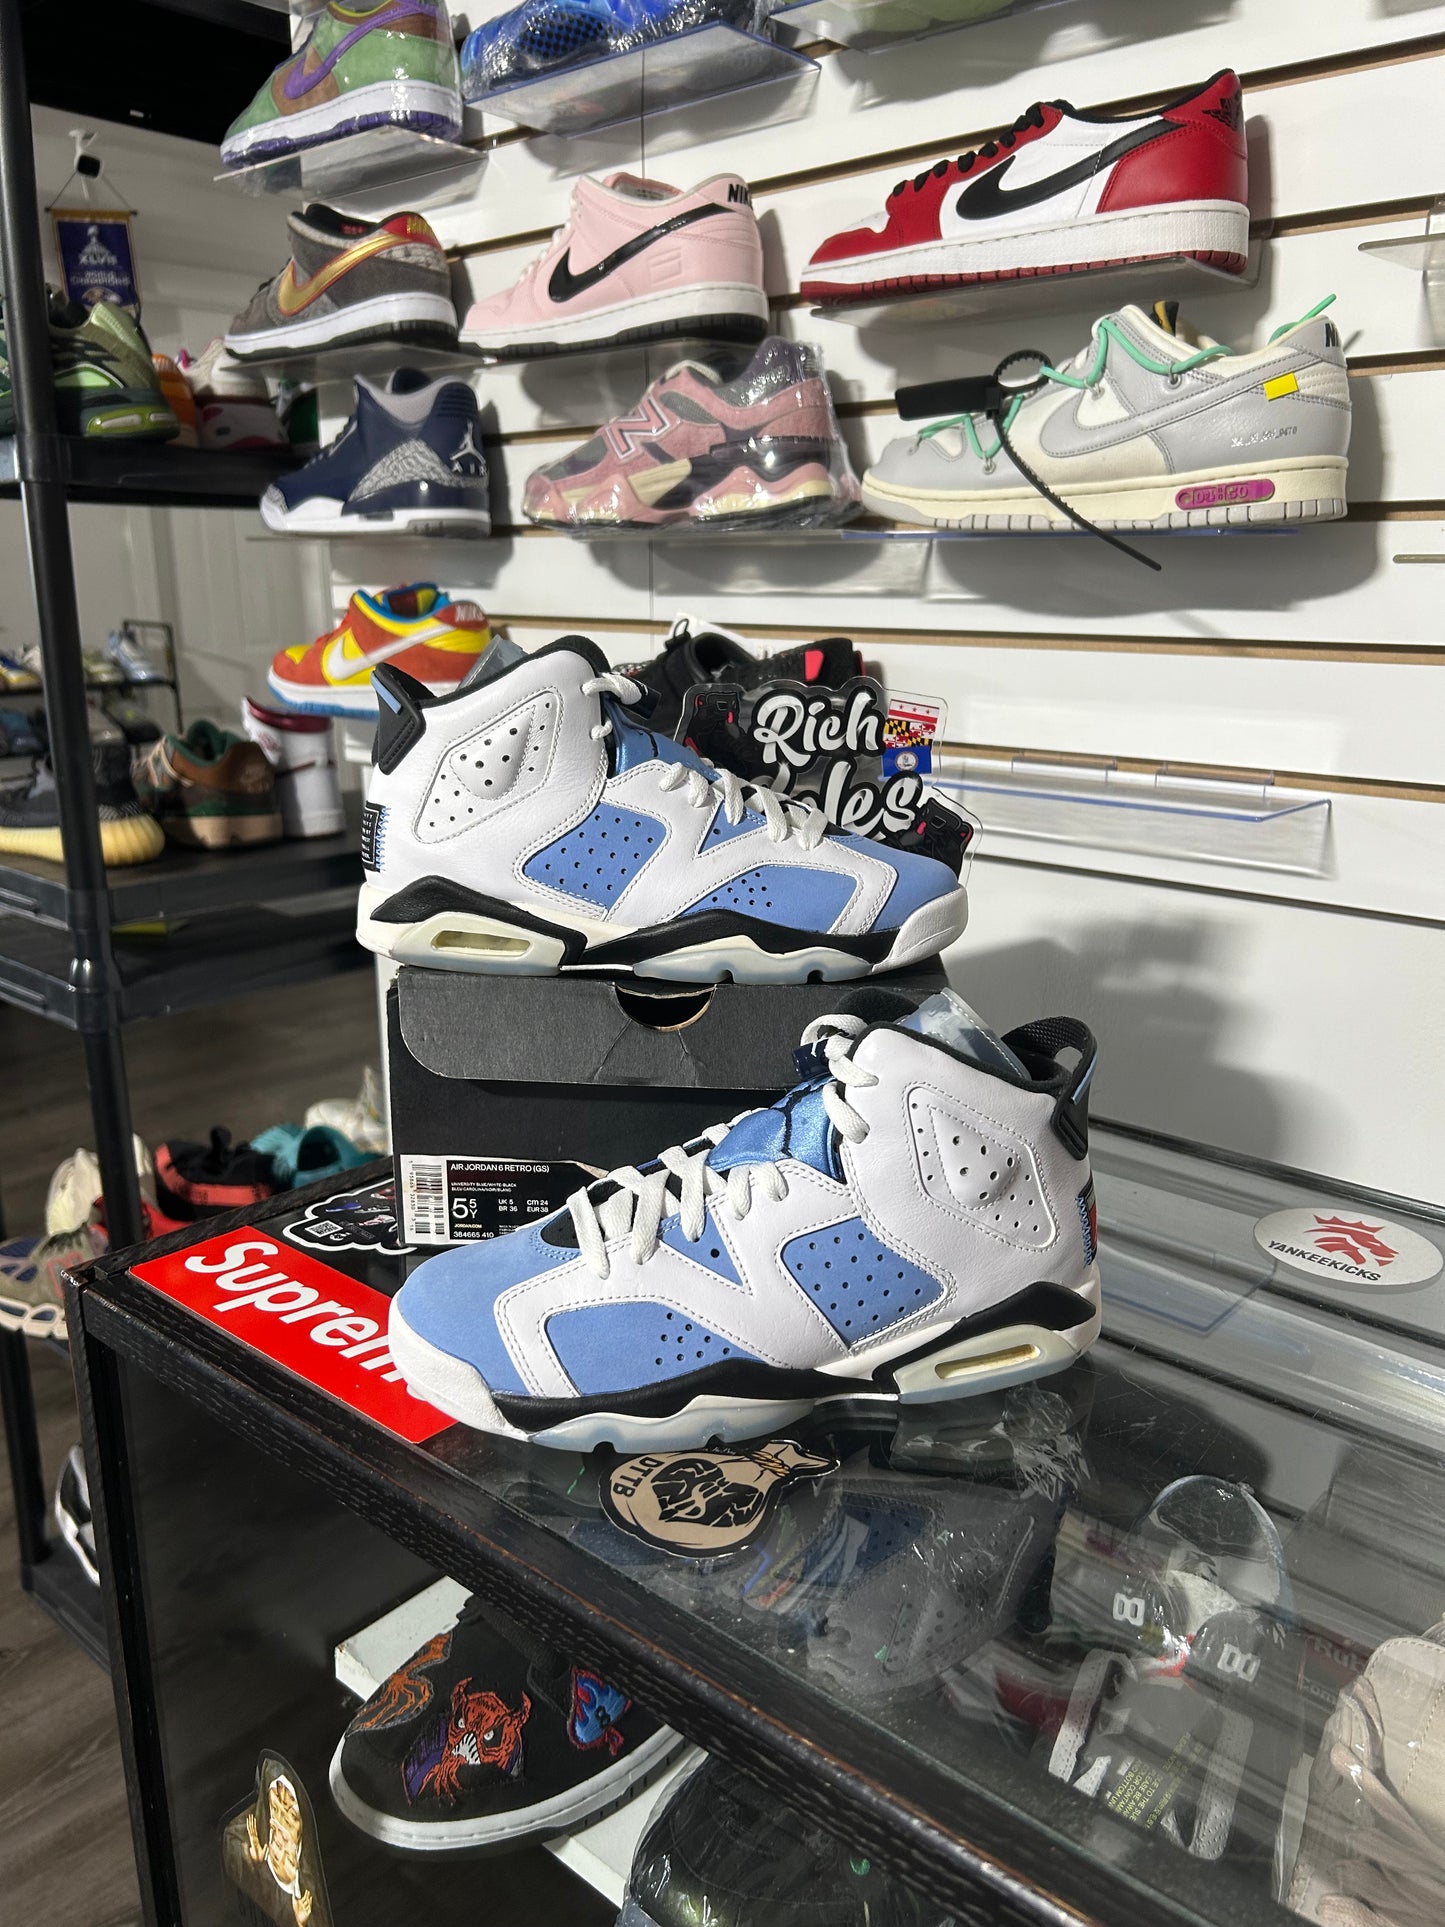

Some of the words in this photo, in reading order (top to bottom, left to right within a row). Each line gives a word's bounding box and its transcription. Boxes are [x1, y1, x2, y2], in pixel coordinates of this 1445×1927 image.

[727, 183, 753, 211] NIK
[753, 691, 879, 767] Rich
[450, 1163, 464, 1171] AIR
[464, 1163, 497, 1172] JORDAN
[498, 1164, 504, 1172] 6
[504, 1164, 532, 1172] RETRO
[532, 1164, 550, 1173] (GS)
[452, 1197, 469, 1219] 5
[469, 1198, 477, 1209] 5
[469, 1208, 478, 1219] Y
[1267, 1240, 1382, 1282] YANKEEKICKS
[184, 1241, 427, 1401] Suprem
[612, 1456, 666, 1498] DTTB
[1114, 1770, 1135, 1797] BOTTOM
[1145, 1786, 1155, 1797] TO
[1132, 1790, 1142, 1801] BE
[1137, 1795, 1149, 1809] THE
